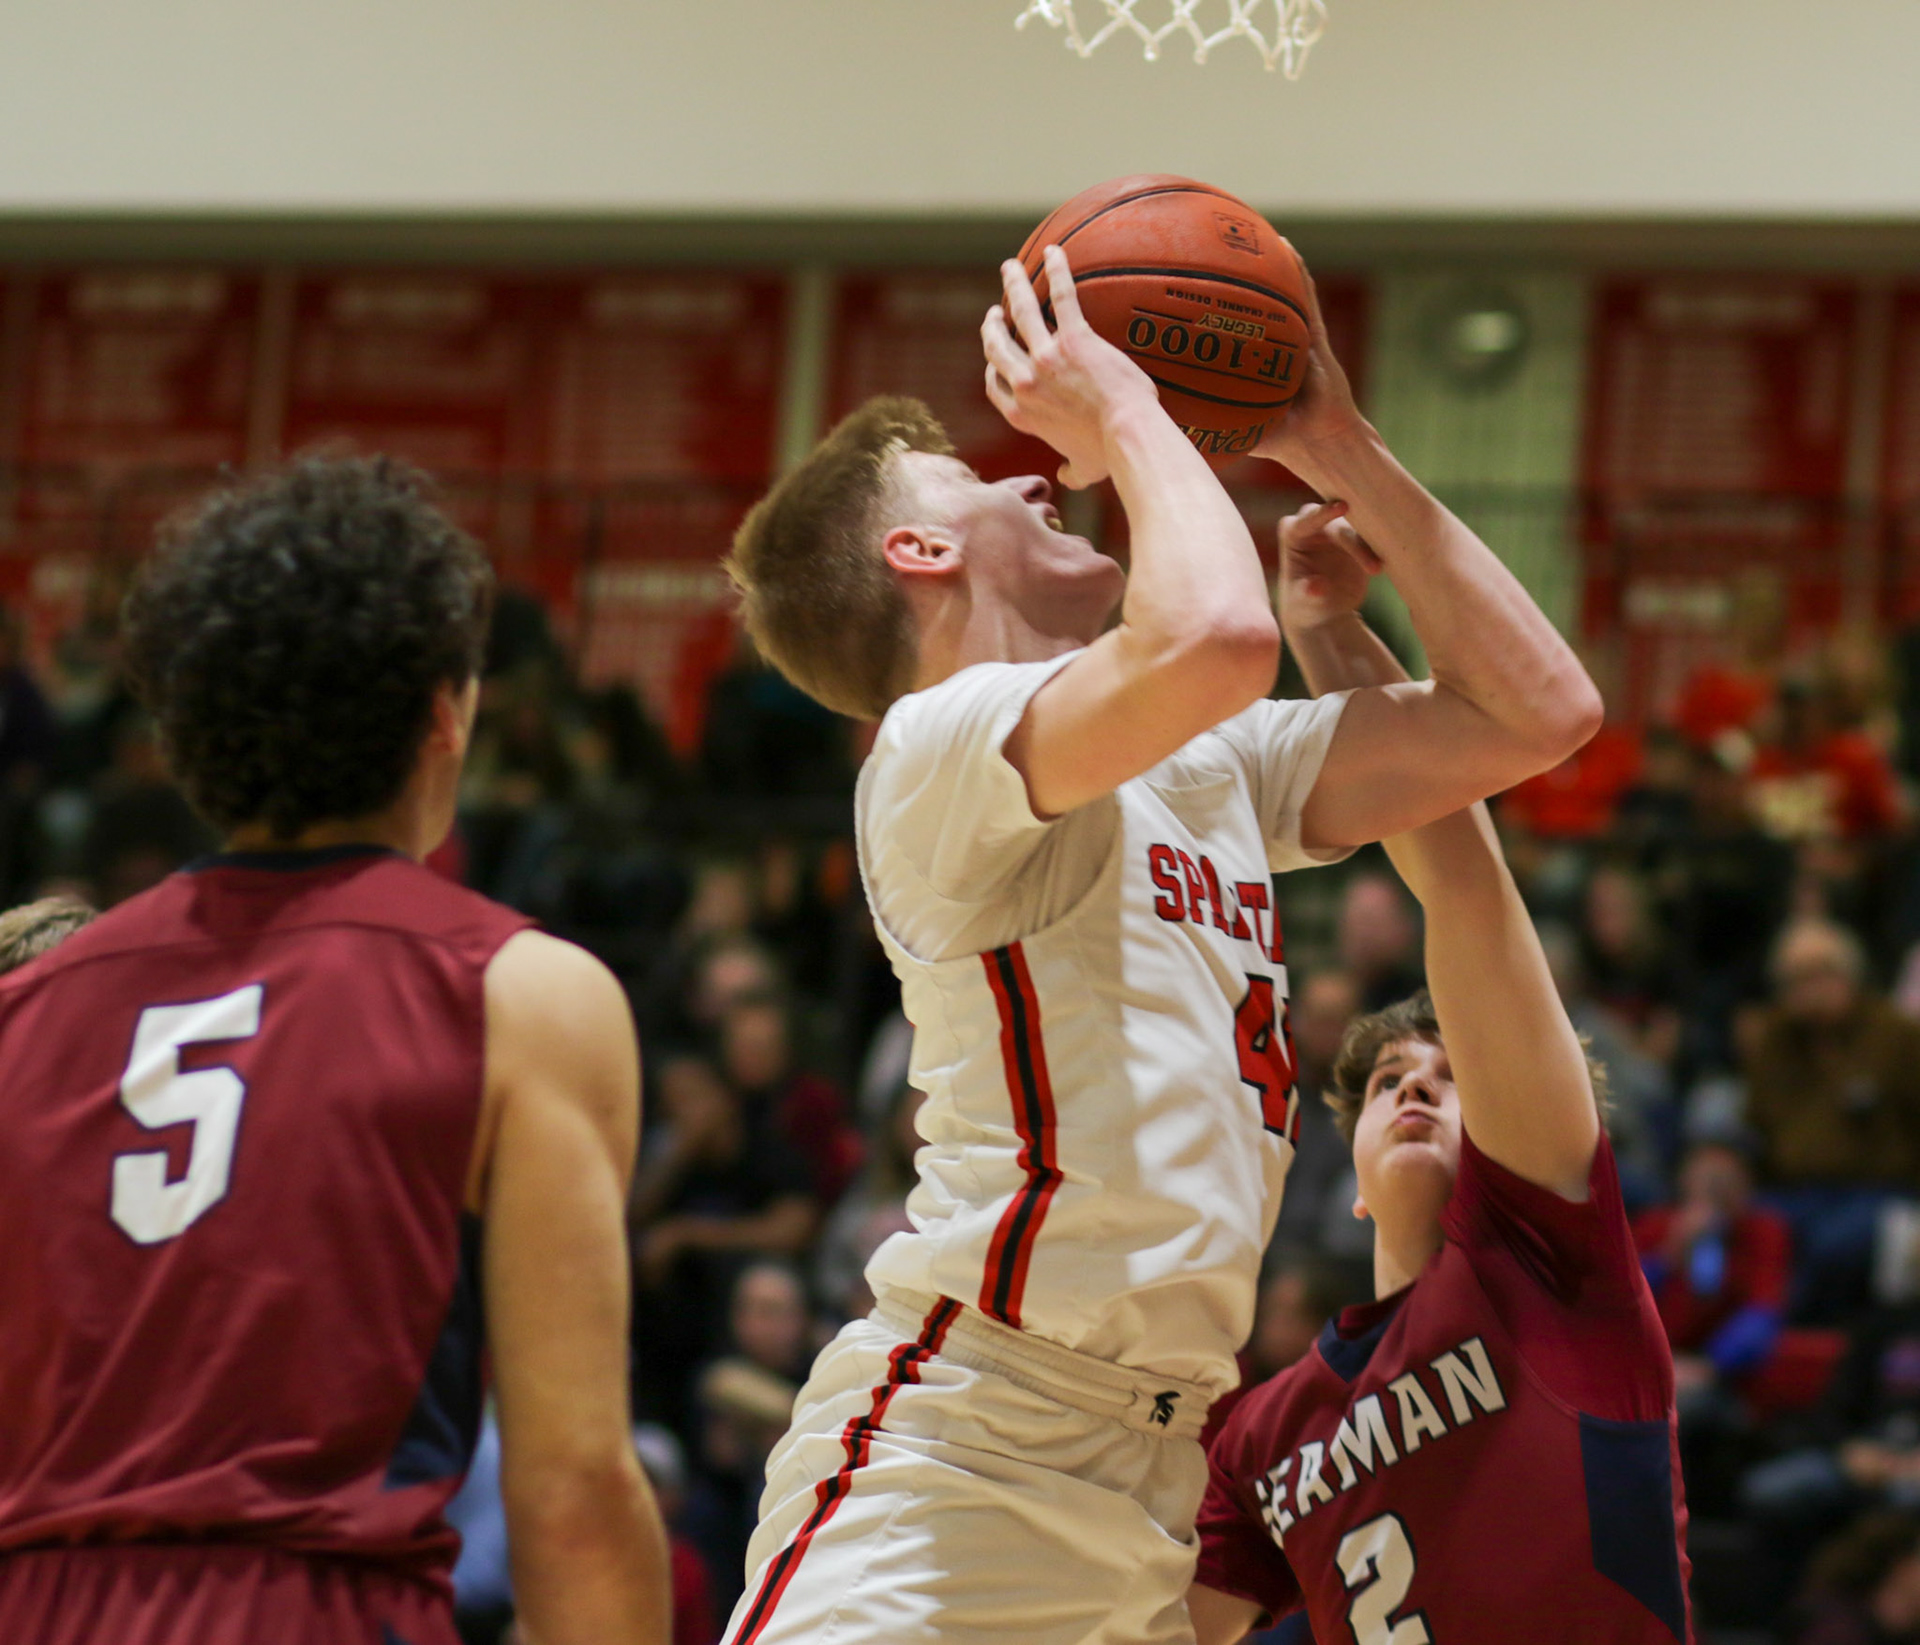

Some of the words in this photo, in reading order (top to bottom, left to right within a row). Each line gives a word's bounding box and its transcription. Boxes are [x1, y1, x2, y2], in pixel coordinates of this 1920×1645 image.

[1165, 287, 1211, 305] DESIGN
[1195, 311, 1266, 341] LEGACY
[1217, 299, 1264, 317] CHANNEL
[1127, 316, 1295, 383] TF-1000
[1234, 972, 1300, 1152] 4
[110, 982, 264, 1245] 5
[1335, 1511, 1432, 1645] 2
